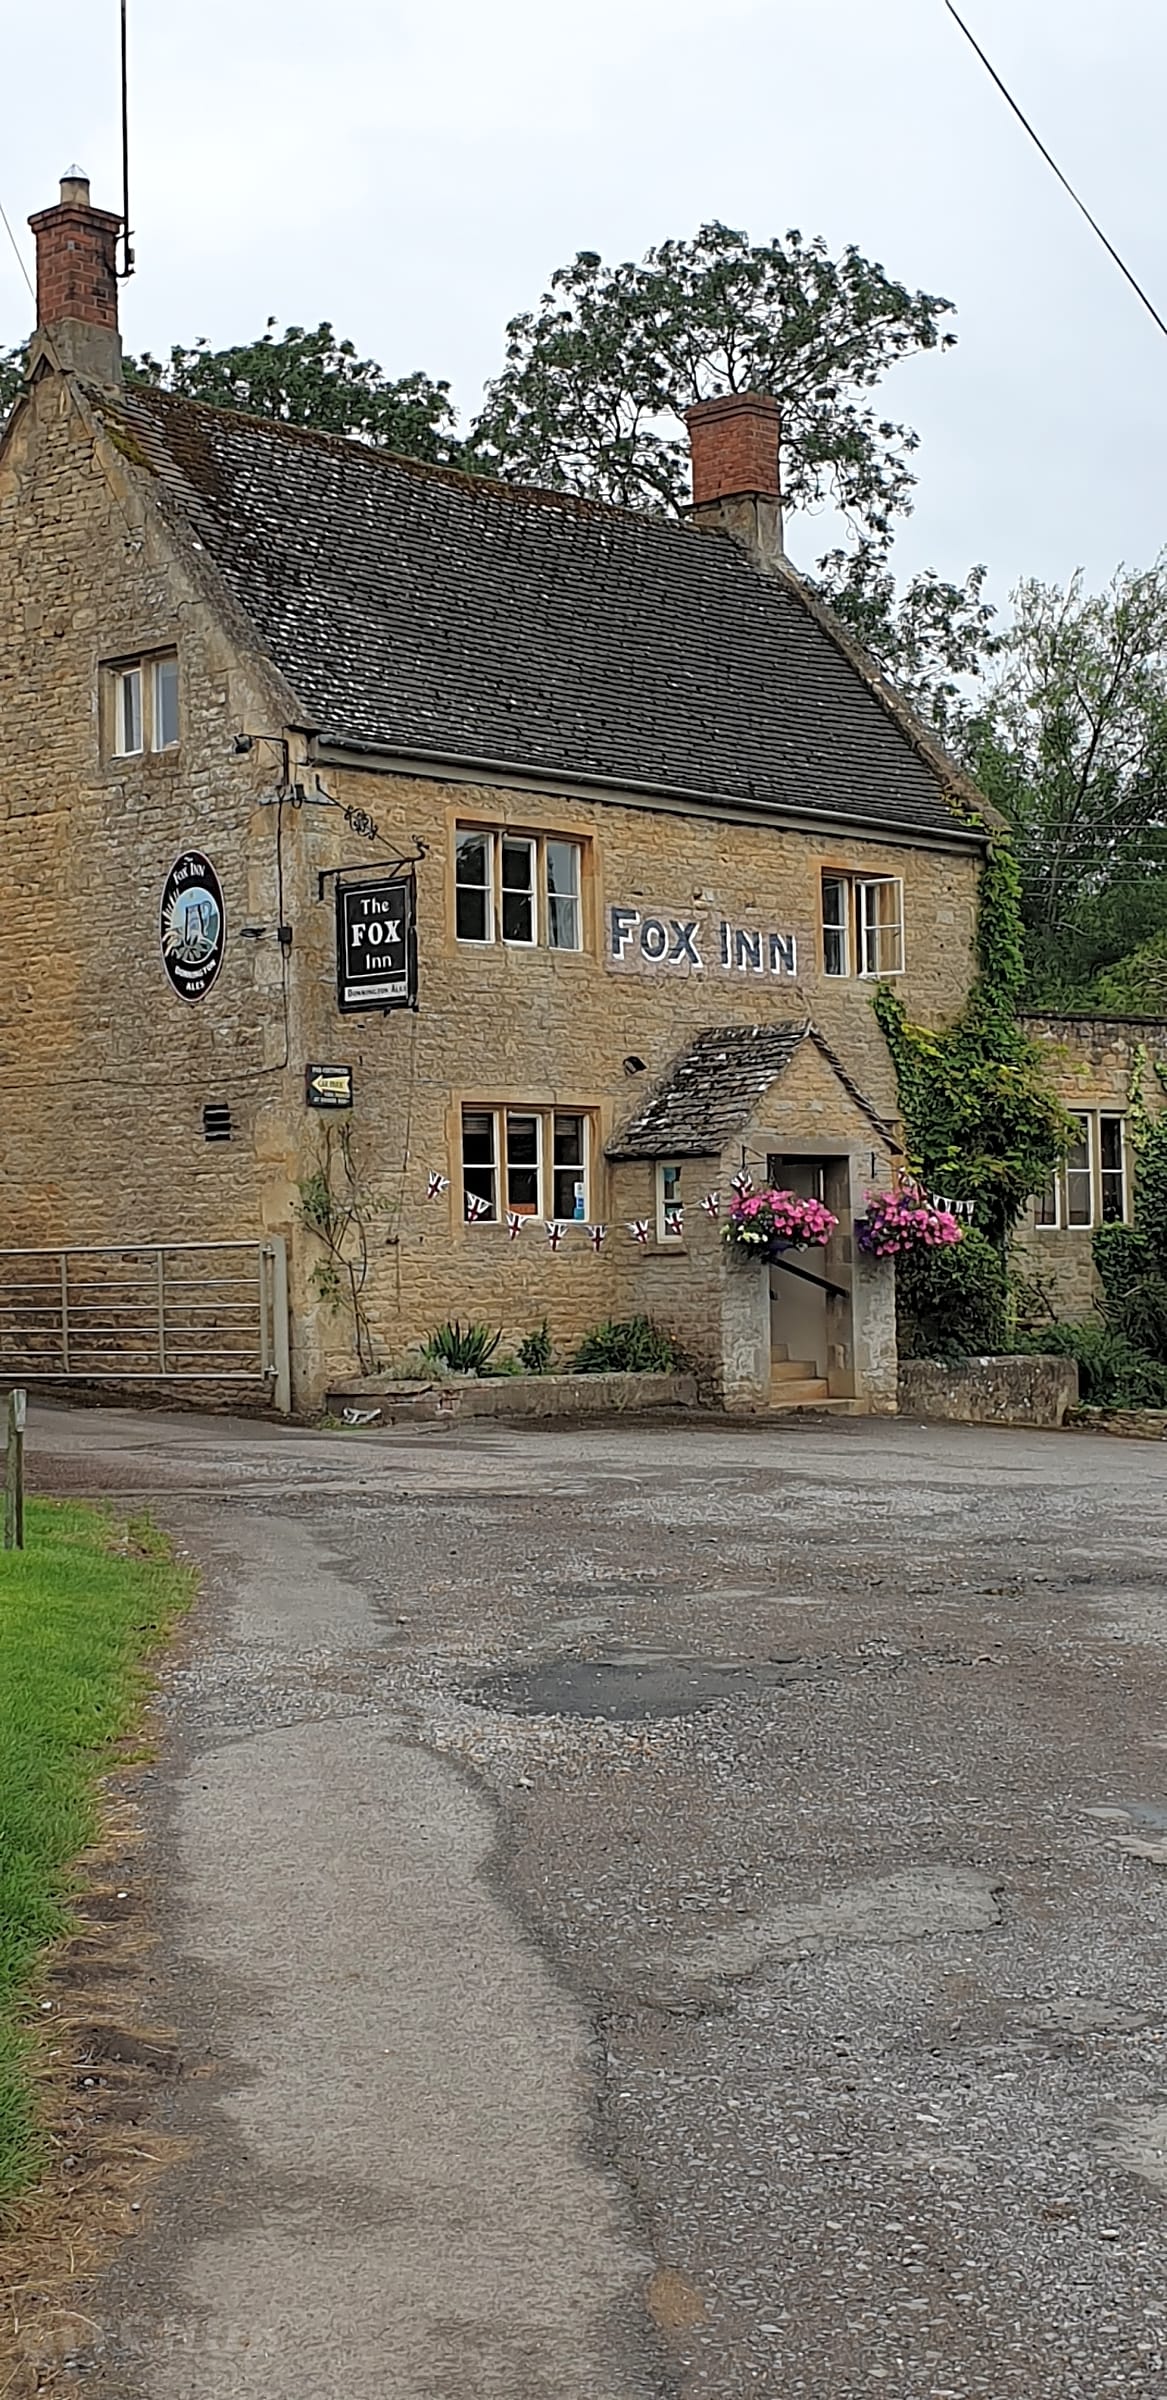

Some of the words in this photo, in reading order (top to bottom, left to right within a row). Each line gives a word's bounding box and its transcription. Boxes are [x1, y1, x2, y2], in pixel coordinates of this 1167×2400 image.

[190, 862, 205, 877] INN
[361, 897, 389, 915] The
[351, 919, 401, 947] FOX
[611, 907, 704, 969] FOX
[719, 920, 797, 977] INN
[366, 953, 392, 970] Inn
[186, 980, 205, 991] ALES
